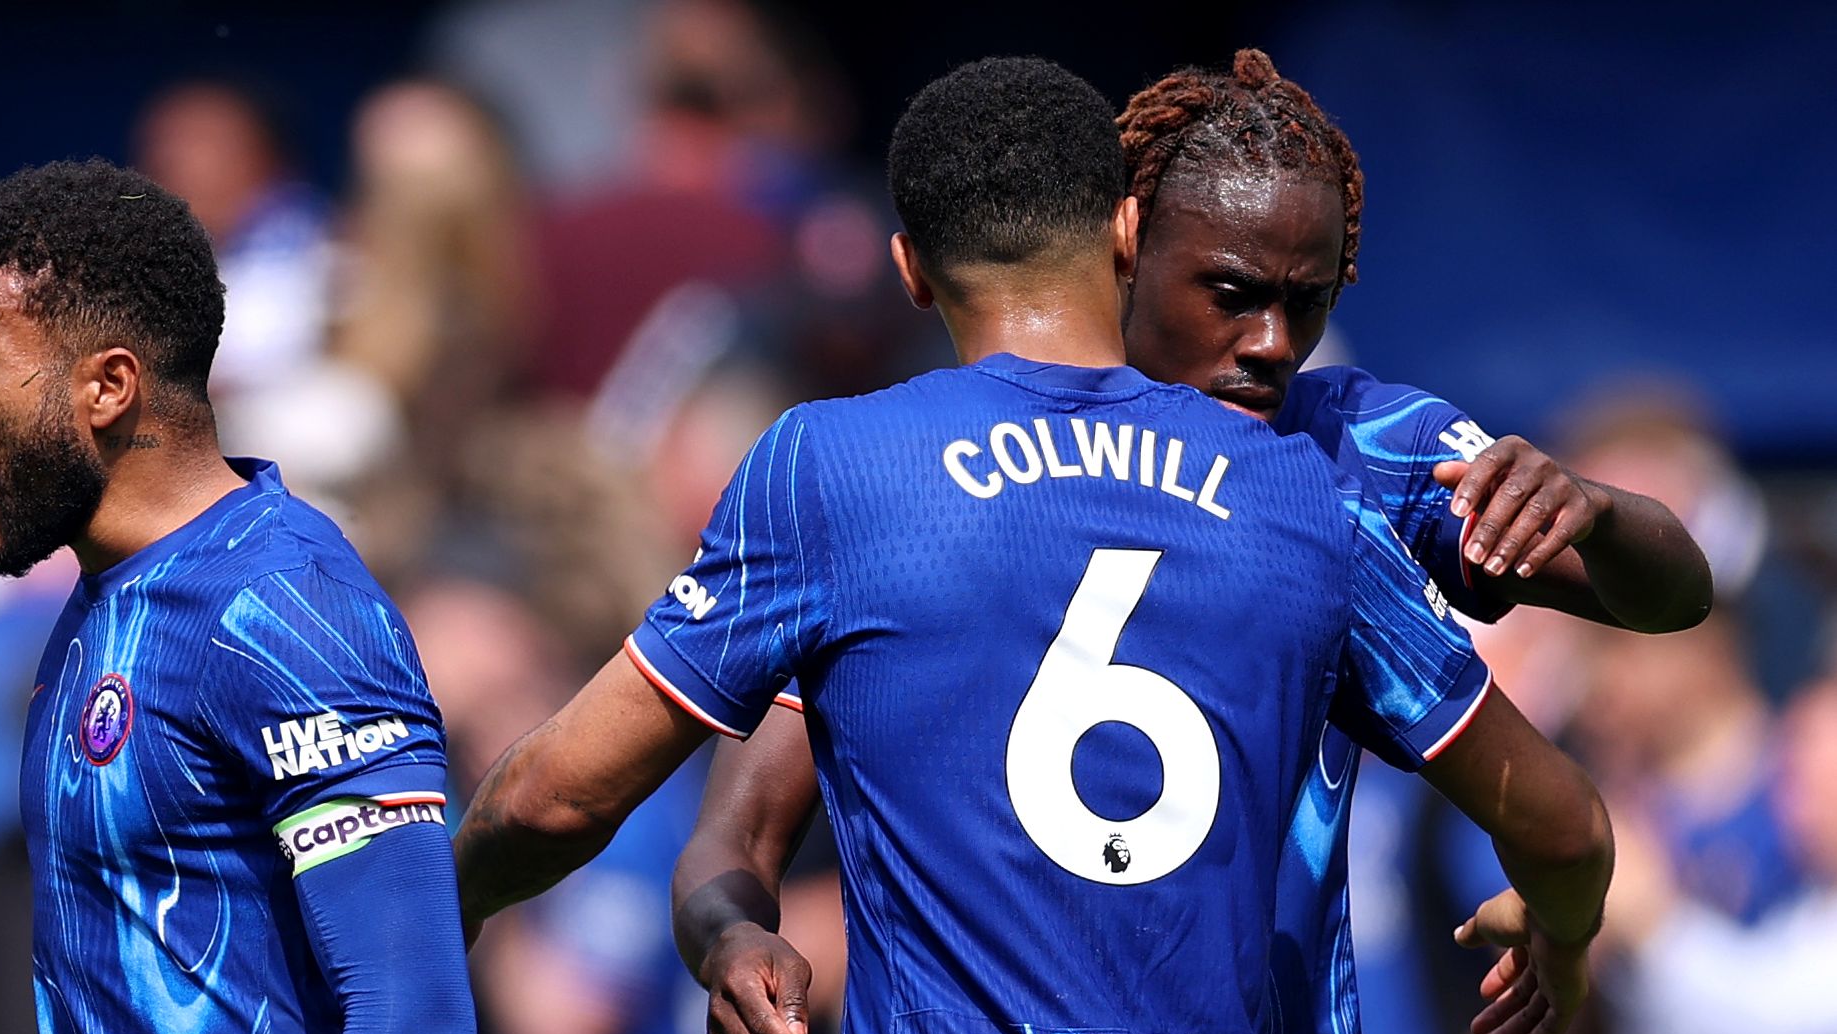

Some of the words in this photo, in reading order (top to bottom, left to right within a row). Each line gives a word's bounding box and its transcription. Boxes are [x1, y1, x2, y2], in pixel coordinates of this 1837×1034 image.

[943, 418, 1231, 520] COLWILL
[261, 711, 343, 755] LIVE
[269, 715, 409, 780] NATION
[1006, 548, 1220, 885] 6
